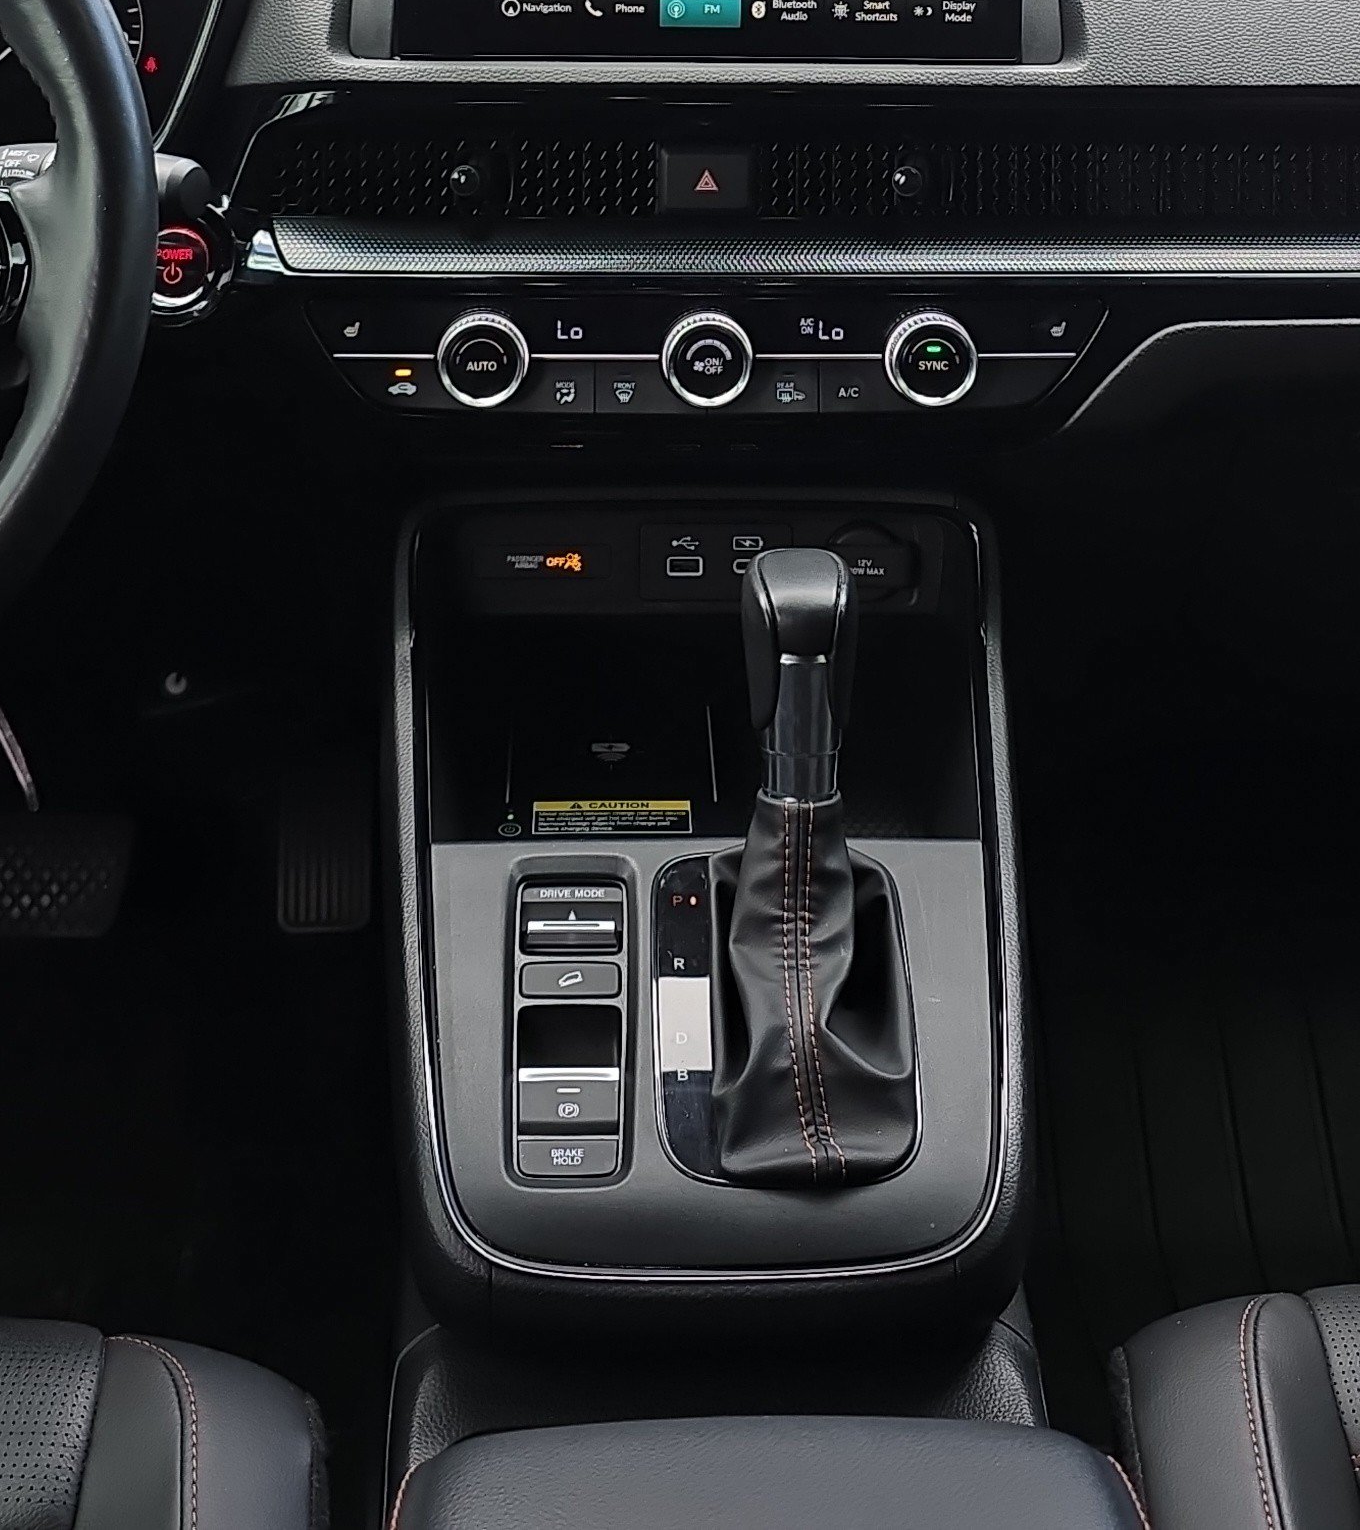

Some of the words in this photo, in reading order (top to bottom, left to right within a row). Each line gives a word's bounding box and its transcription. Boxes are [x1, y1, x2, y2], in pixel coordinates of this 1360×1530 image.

[522, 2, 572, 15] Navigation
[615, 3, 645, 14] Phone
[704, 4, 721, 14] FM
[772, 0, 818, 10] Bluetooth
[863, 0, 890, 10] Smart
[942, 0, 977, 13] Display
[780, 11, 808, 21] Audio
[855, 11, 898, 22] Shortcuts
[944, 12, 973, 23] Mode
[799, 317, 816, 327] A/C
[557, 320, 583, 340] Lo
[800, 326, 814, 335] ON
[819, 320, 845, 341] Lo
[466, 360, 498, 372] AUTO
[704, 365, 724, 375] OFF
[918, 360, 950, 371] SYNC
[555, 381, 576, 389] MODE
[613, 382, 636, 390] FRONT
[838, 387, 860, 398] A/C
[545, 557, 566, 567] OFF
[857, 559, 873, 567] 12V
[866, 567, 885, 576] MAX
[539, 888, 571, 899] DRIVE
[574, 888, 606, 899] MODE
[672, 895, 683, 907] P
[673, 958, 686, 970] R
[675, 1032, 687, 1044] D
[677, 1070, 689, 1082] B
[550, 1148, 585, 1158] BRAKE
[552, 1155, 583, 1165] HOLD
